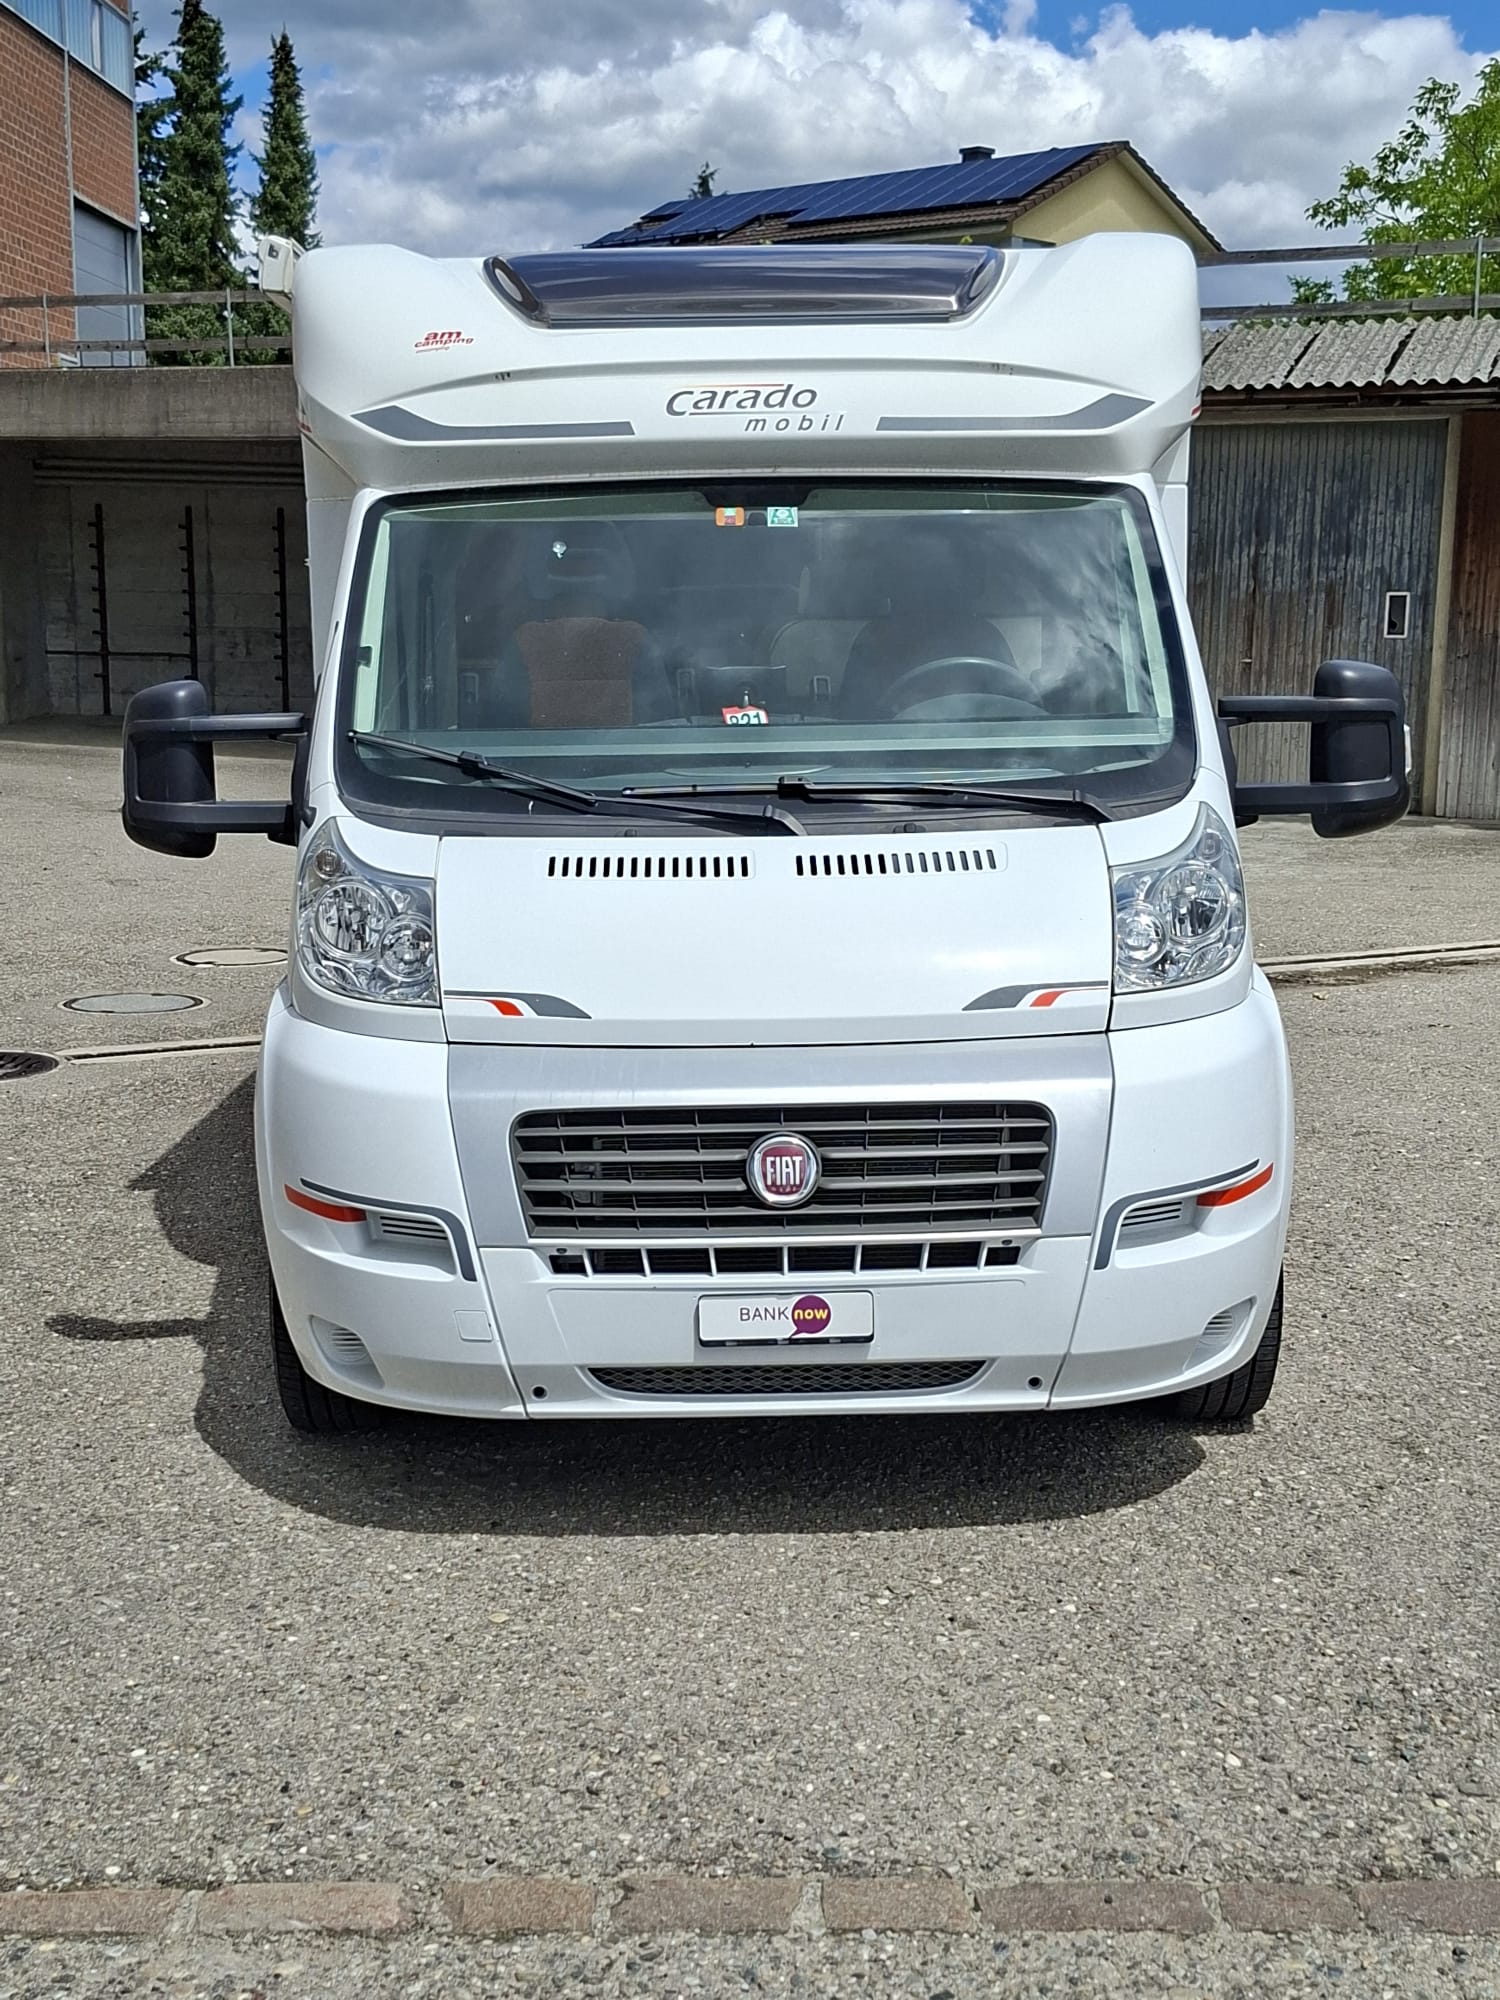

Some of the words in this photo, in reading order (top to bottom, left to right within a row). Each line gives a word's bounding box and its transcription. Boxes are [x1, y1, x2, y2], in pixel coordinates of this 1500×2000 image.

[414, 338, 474, 348] camping
[424, 331, 462, 341] am
[744, 414, 845, 432] mobil
[766, 1156, 803, 1186] FIAT
[740, 1307, 789, 1322] BANK
[794, 1308, 829, 1320] now
